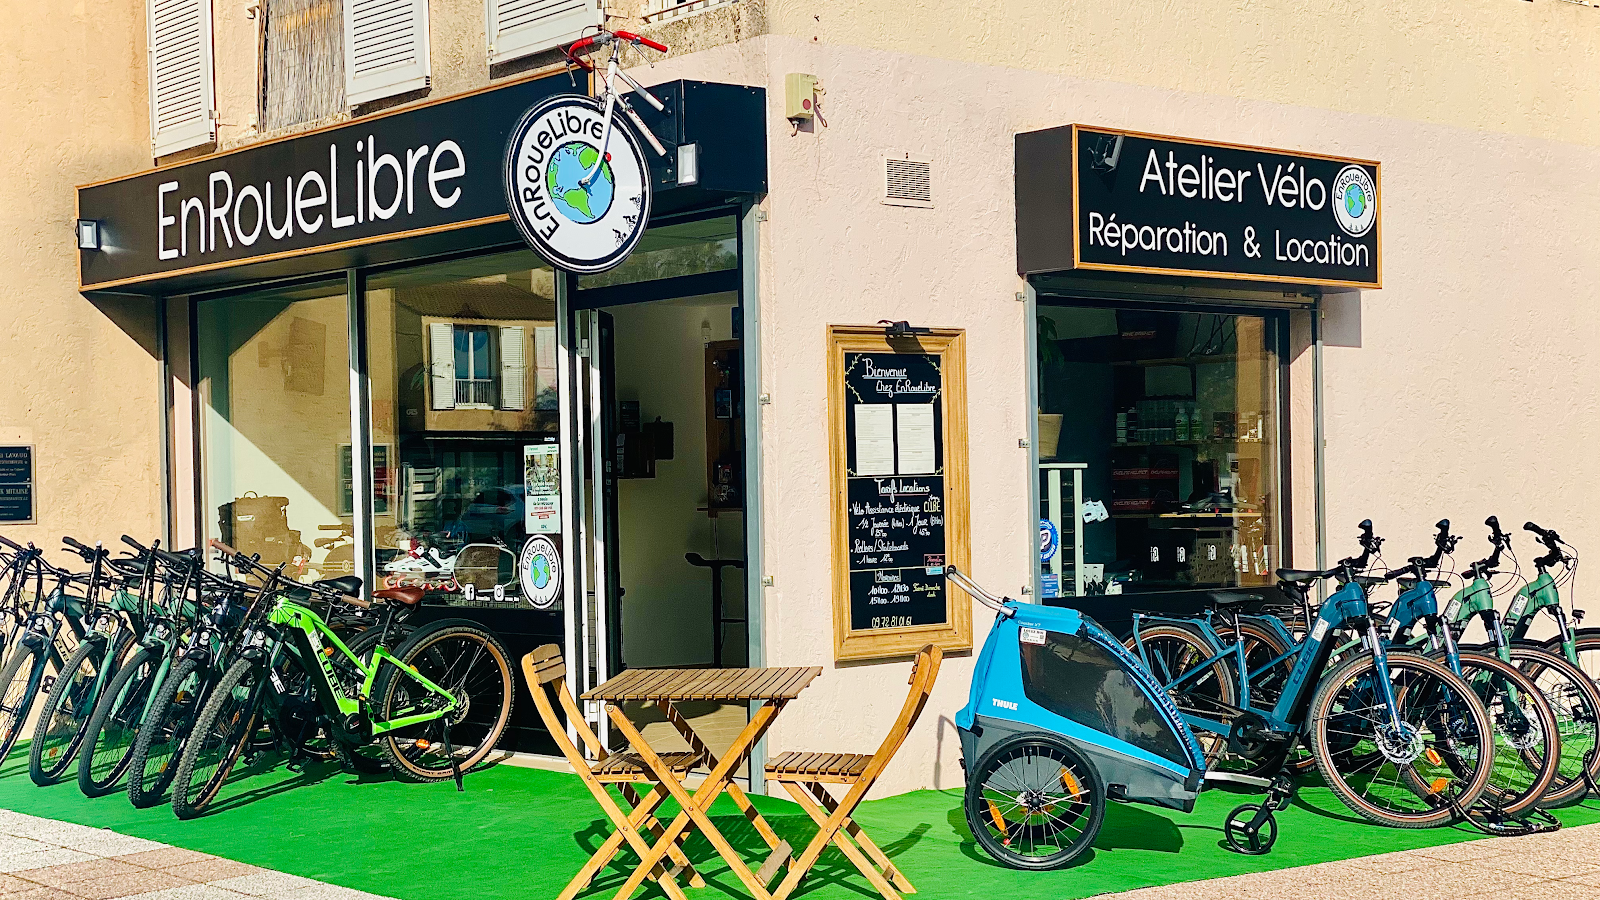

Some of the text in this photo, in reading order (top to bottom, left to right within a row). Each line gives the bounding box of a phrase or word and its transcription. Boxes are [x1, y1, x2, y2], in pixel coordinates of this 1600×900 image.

[158, 134, 466, 261] EnRoueLibre
[523, 110, 604, 241] EnRoueLibre
[1139, 148, 1327, 211] Atelier Vélo
[1088, 211, 1370, 268] Réparation & Location
[862, 357, 908, 378] Bienvenue
[876, 379, 894, 399] Chez
[873, 478, 931, 504] Tarifs Locations
[923, 500, 942, 513] CUBE
[316, 648, 346, 701] CUBE
[1293, 641, 1317, 685] CUBE
[992, 697, 1019, 711] THULE
